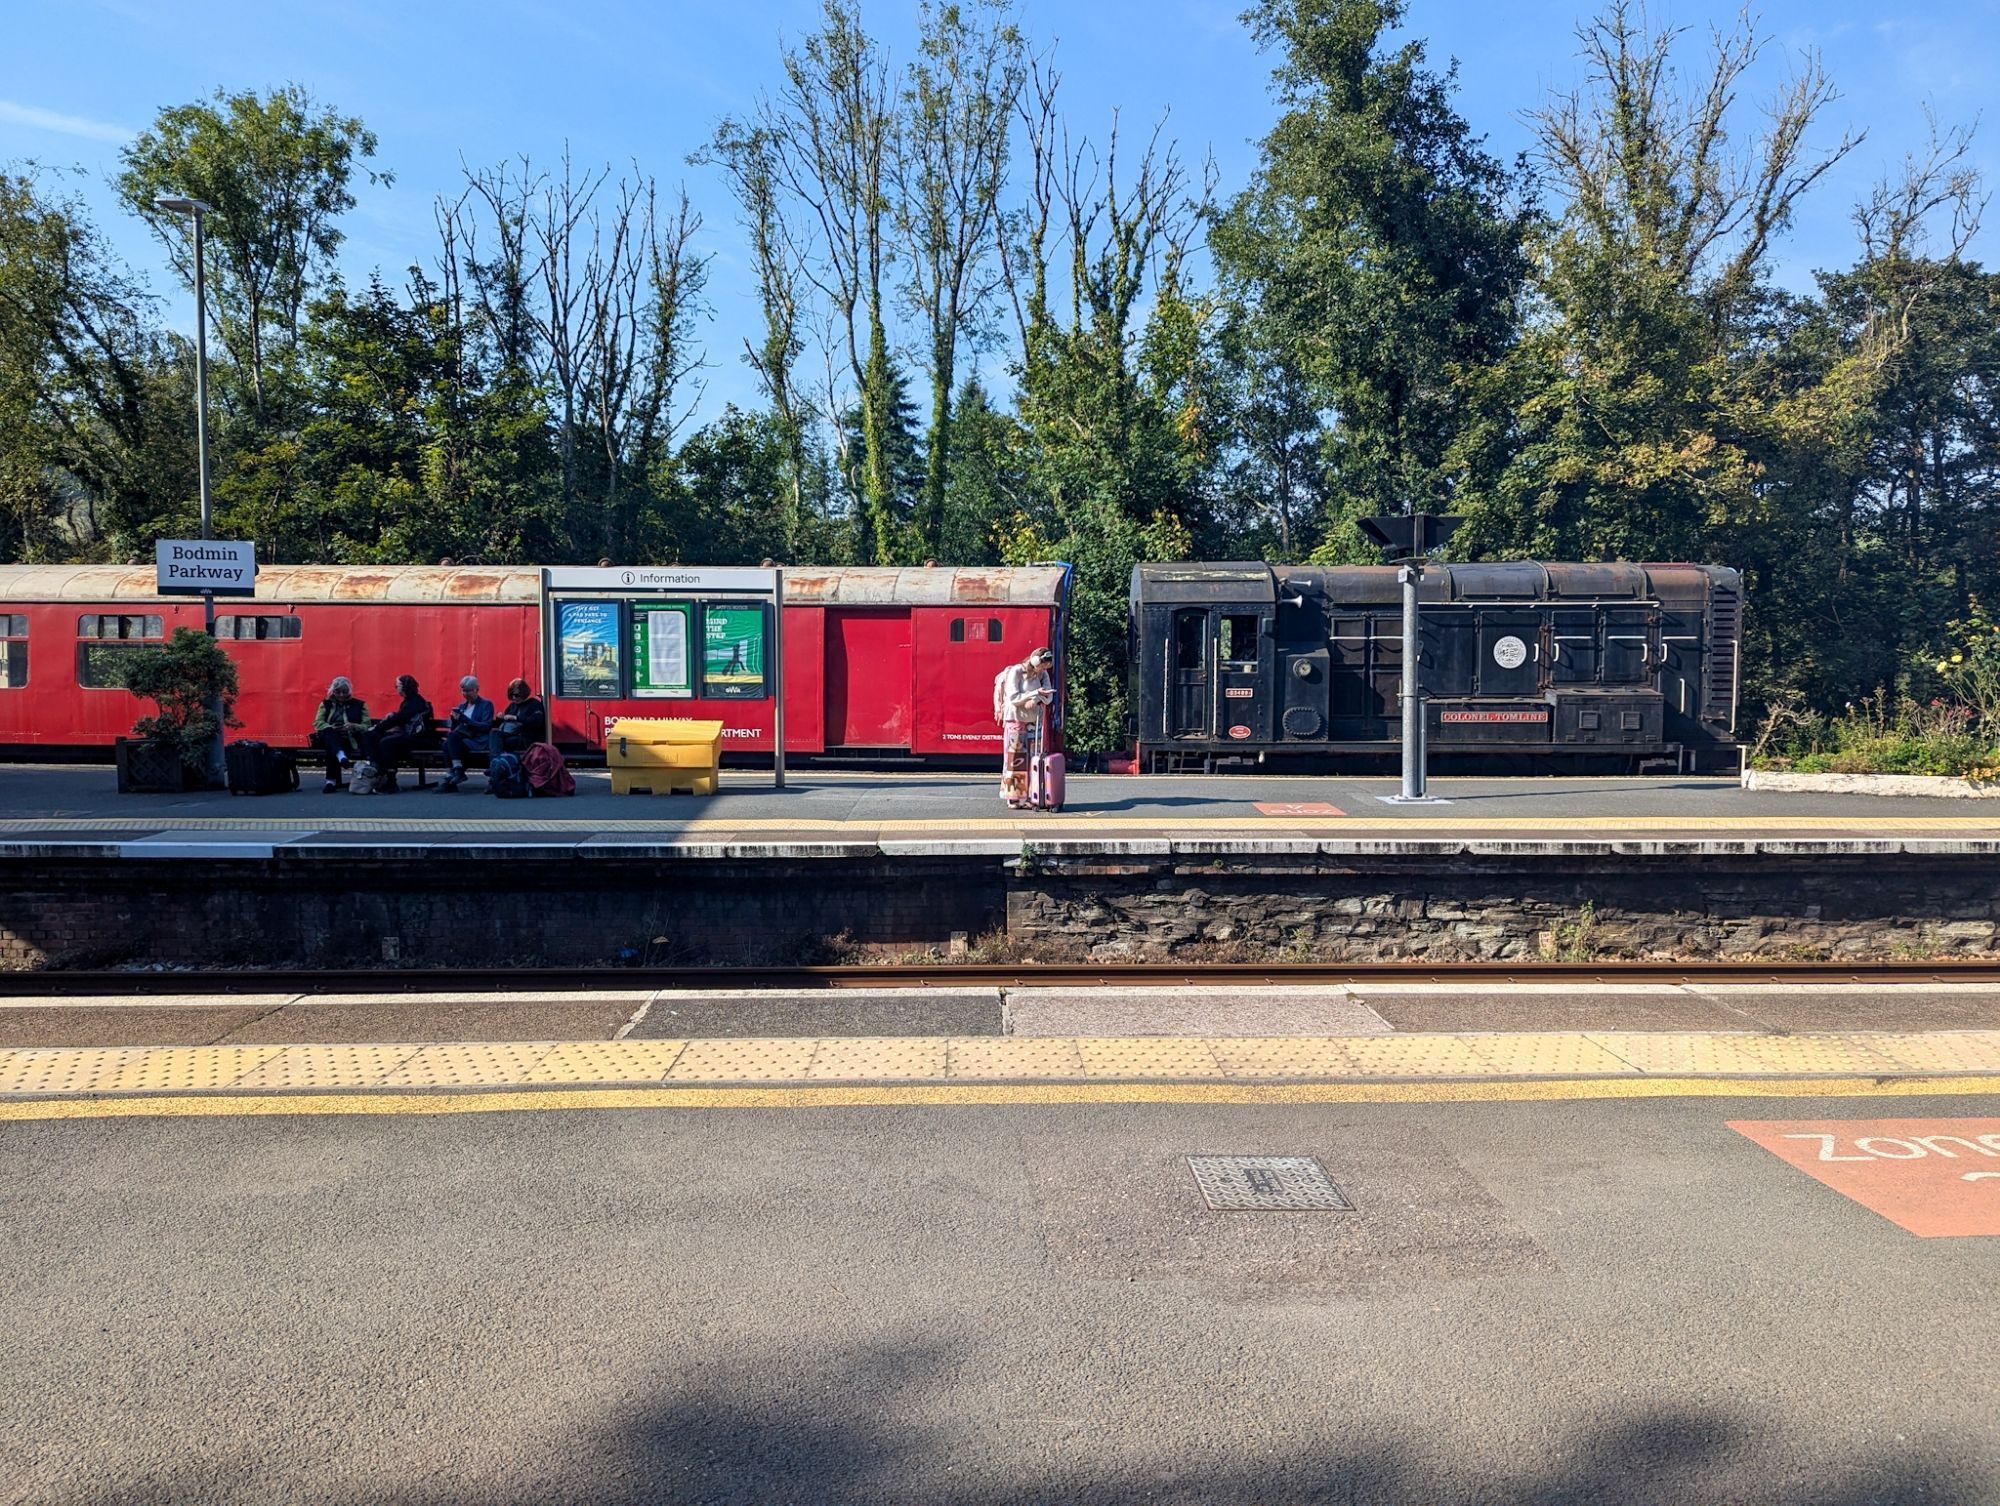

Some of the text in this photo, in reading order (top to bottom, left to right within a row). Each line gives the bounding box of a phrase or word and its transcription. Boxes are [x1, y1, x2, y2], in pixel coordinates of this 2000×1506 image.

[172, 546, 238, 560] Bodmin
[168, 564, 243, 582] Parkway
[640, 573, 701, 584] Information
[1443, 712, 1546, 721] COLONEL TOMLINE
[721, 728, 762, 738] RTMENT
